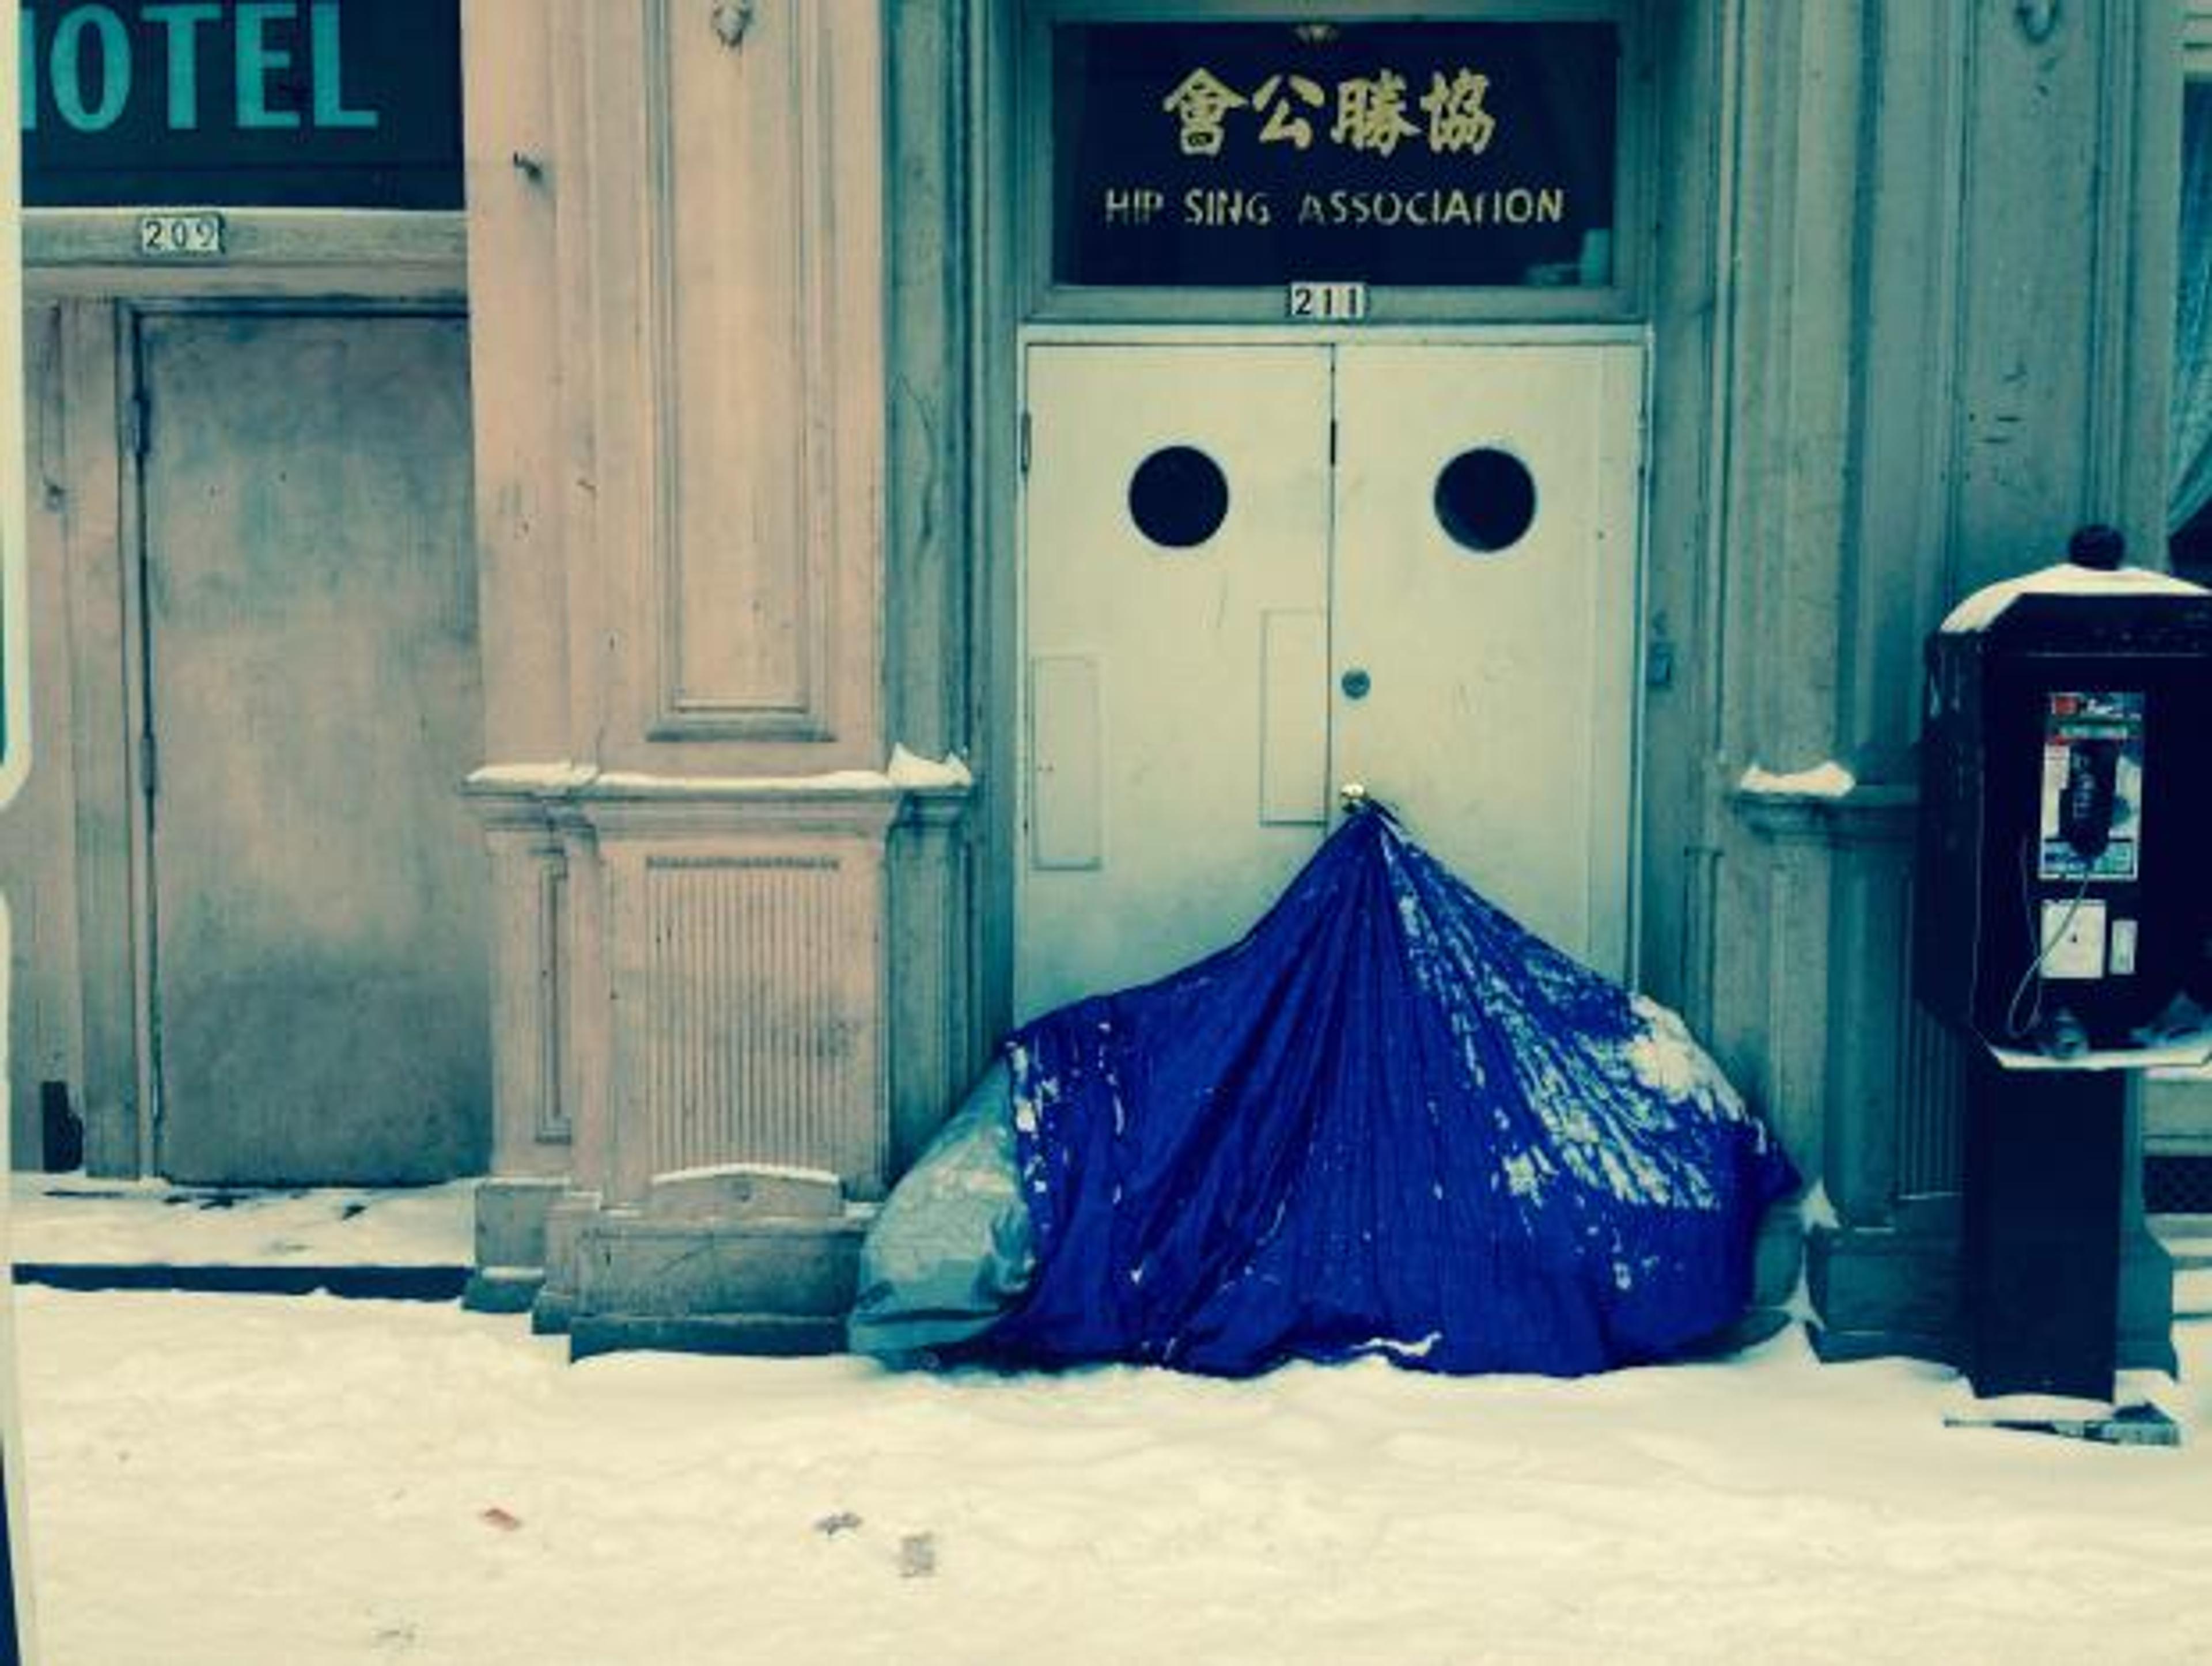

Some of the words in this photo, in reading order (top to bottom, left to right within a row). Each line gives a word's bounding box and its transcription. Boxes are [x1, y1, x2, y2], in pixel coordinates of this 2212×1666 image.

[21, 3, 378, 132] OTEL
[1105, 188, 1164, 224] HIP
[1184, 188, 1270, 225] SING
[1298, 188, 1564, 225] ASSOCIATION
[146, 220, 215, 248] 209
[1296, 288, 1357, 315] 211
